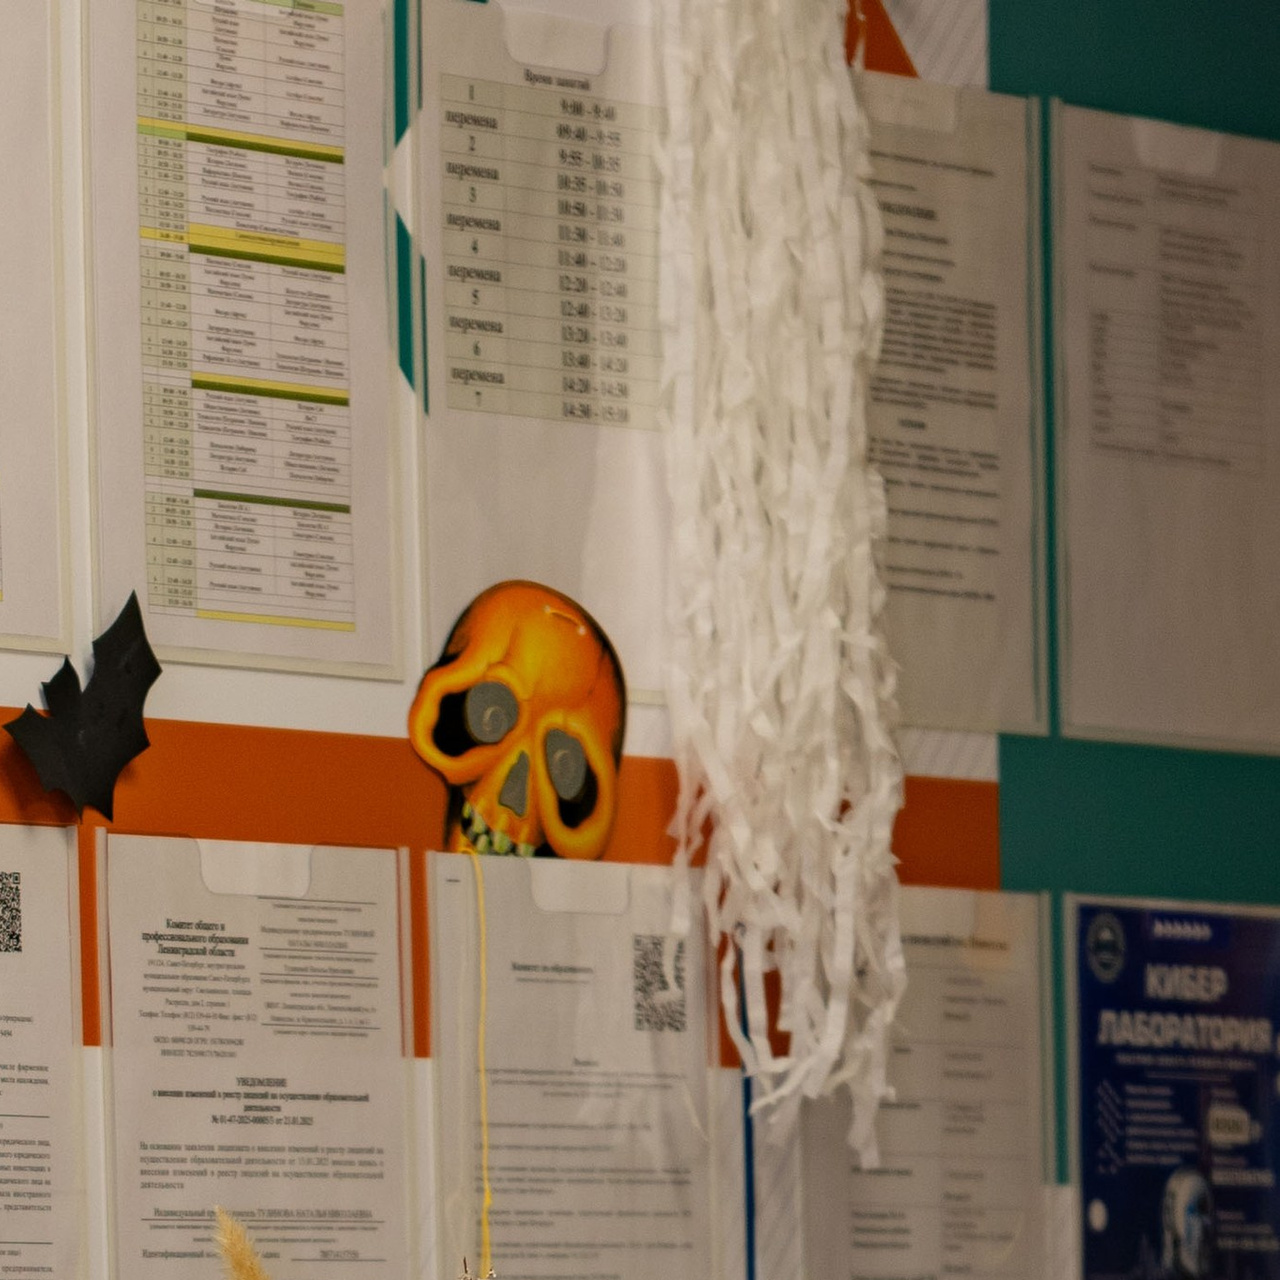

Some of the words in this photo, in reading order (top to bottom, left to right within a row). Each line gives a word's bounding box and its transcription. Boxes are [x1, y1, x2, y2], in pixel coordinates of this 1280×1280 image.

[444, 110, 498, 130] перемена
[445, 161, 499, 181] перемена
[445, 213, 501, 232] перемена
[446, 264, 502, 283] перемена
[448, 315, 503, 334] перемена
[450, 367, 505, 385] перемена
[165, 920, 193, 930] Комитет
[194, 921, 219, 931] общего
[141, 932, 207, 944] профессионального
[207, 935, 249, 946] образования
[157, 945, 207, 956] Ленинградской
[207, 947, 235, 957] области
[1144, 962, 1228, 1003] КИБЕР
[1097, 1009, 1273, 1053] ЛАБОРАТОРИЯ
[236, 1076, 287, 1087] УВЕДОМЛЕНИЕ
[242, 1104, 281, 1113] деятельности
